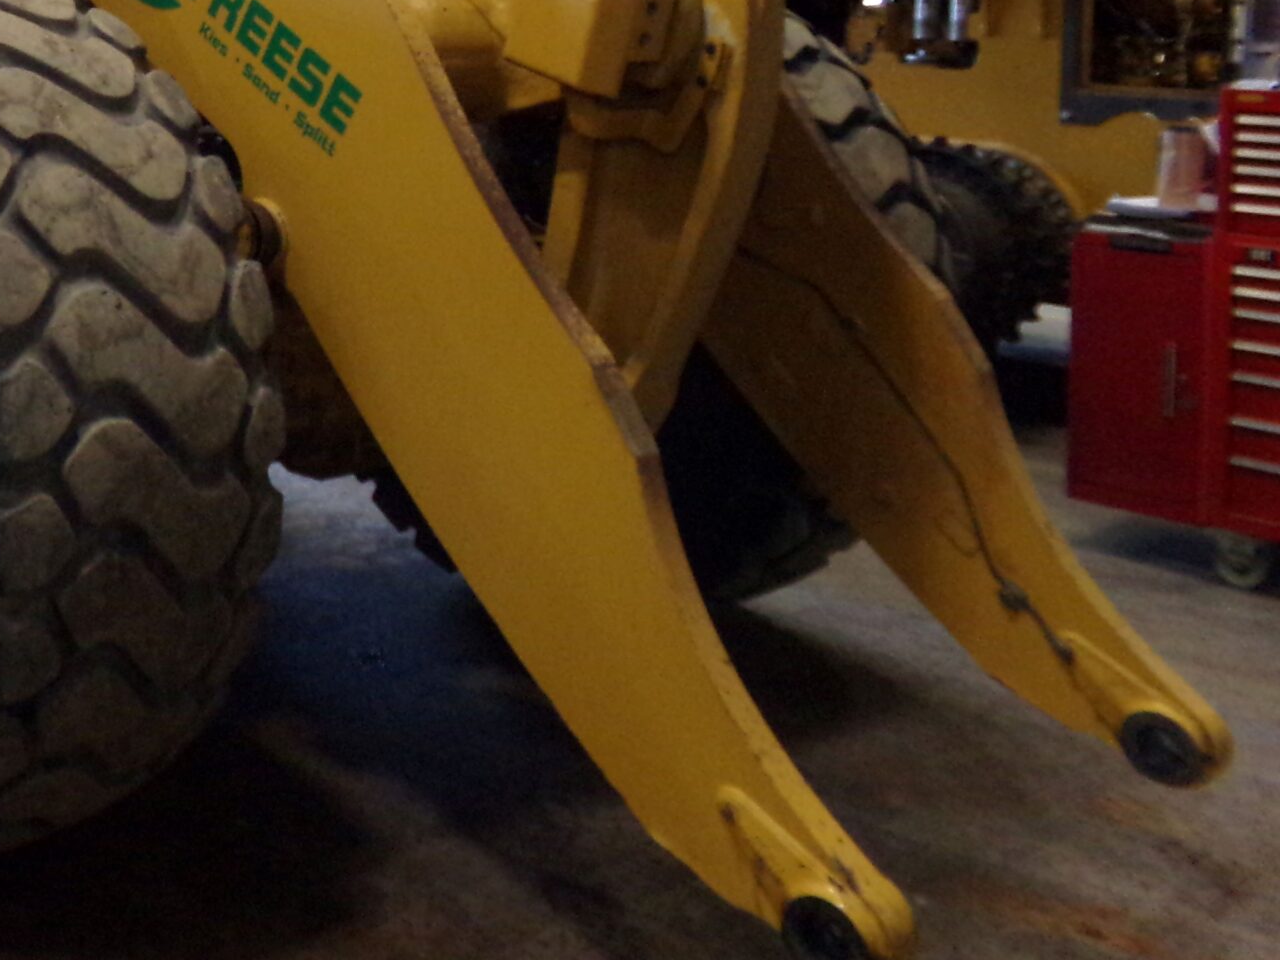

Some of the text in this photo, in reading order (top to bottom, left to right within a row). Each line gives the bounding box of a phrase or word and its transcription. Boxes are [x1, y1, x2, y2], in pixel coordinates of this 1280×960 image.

[199, 22, 337, 157] Kies Sand Splitt
